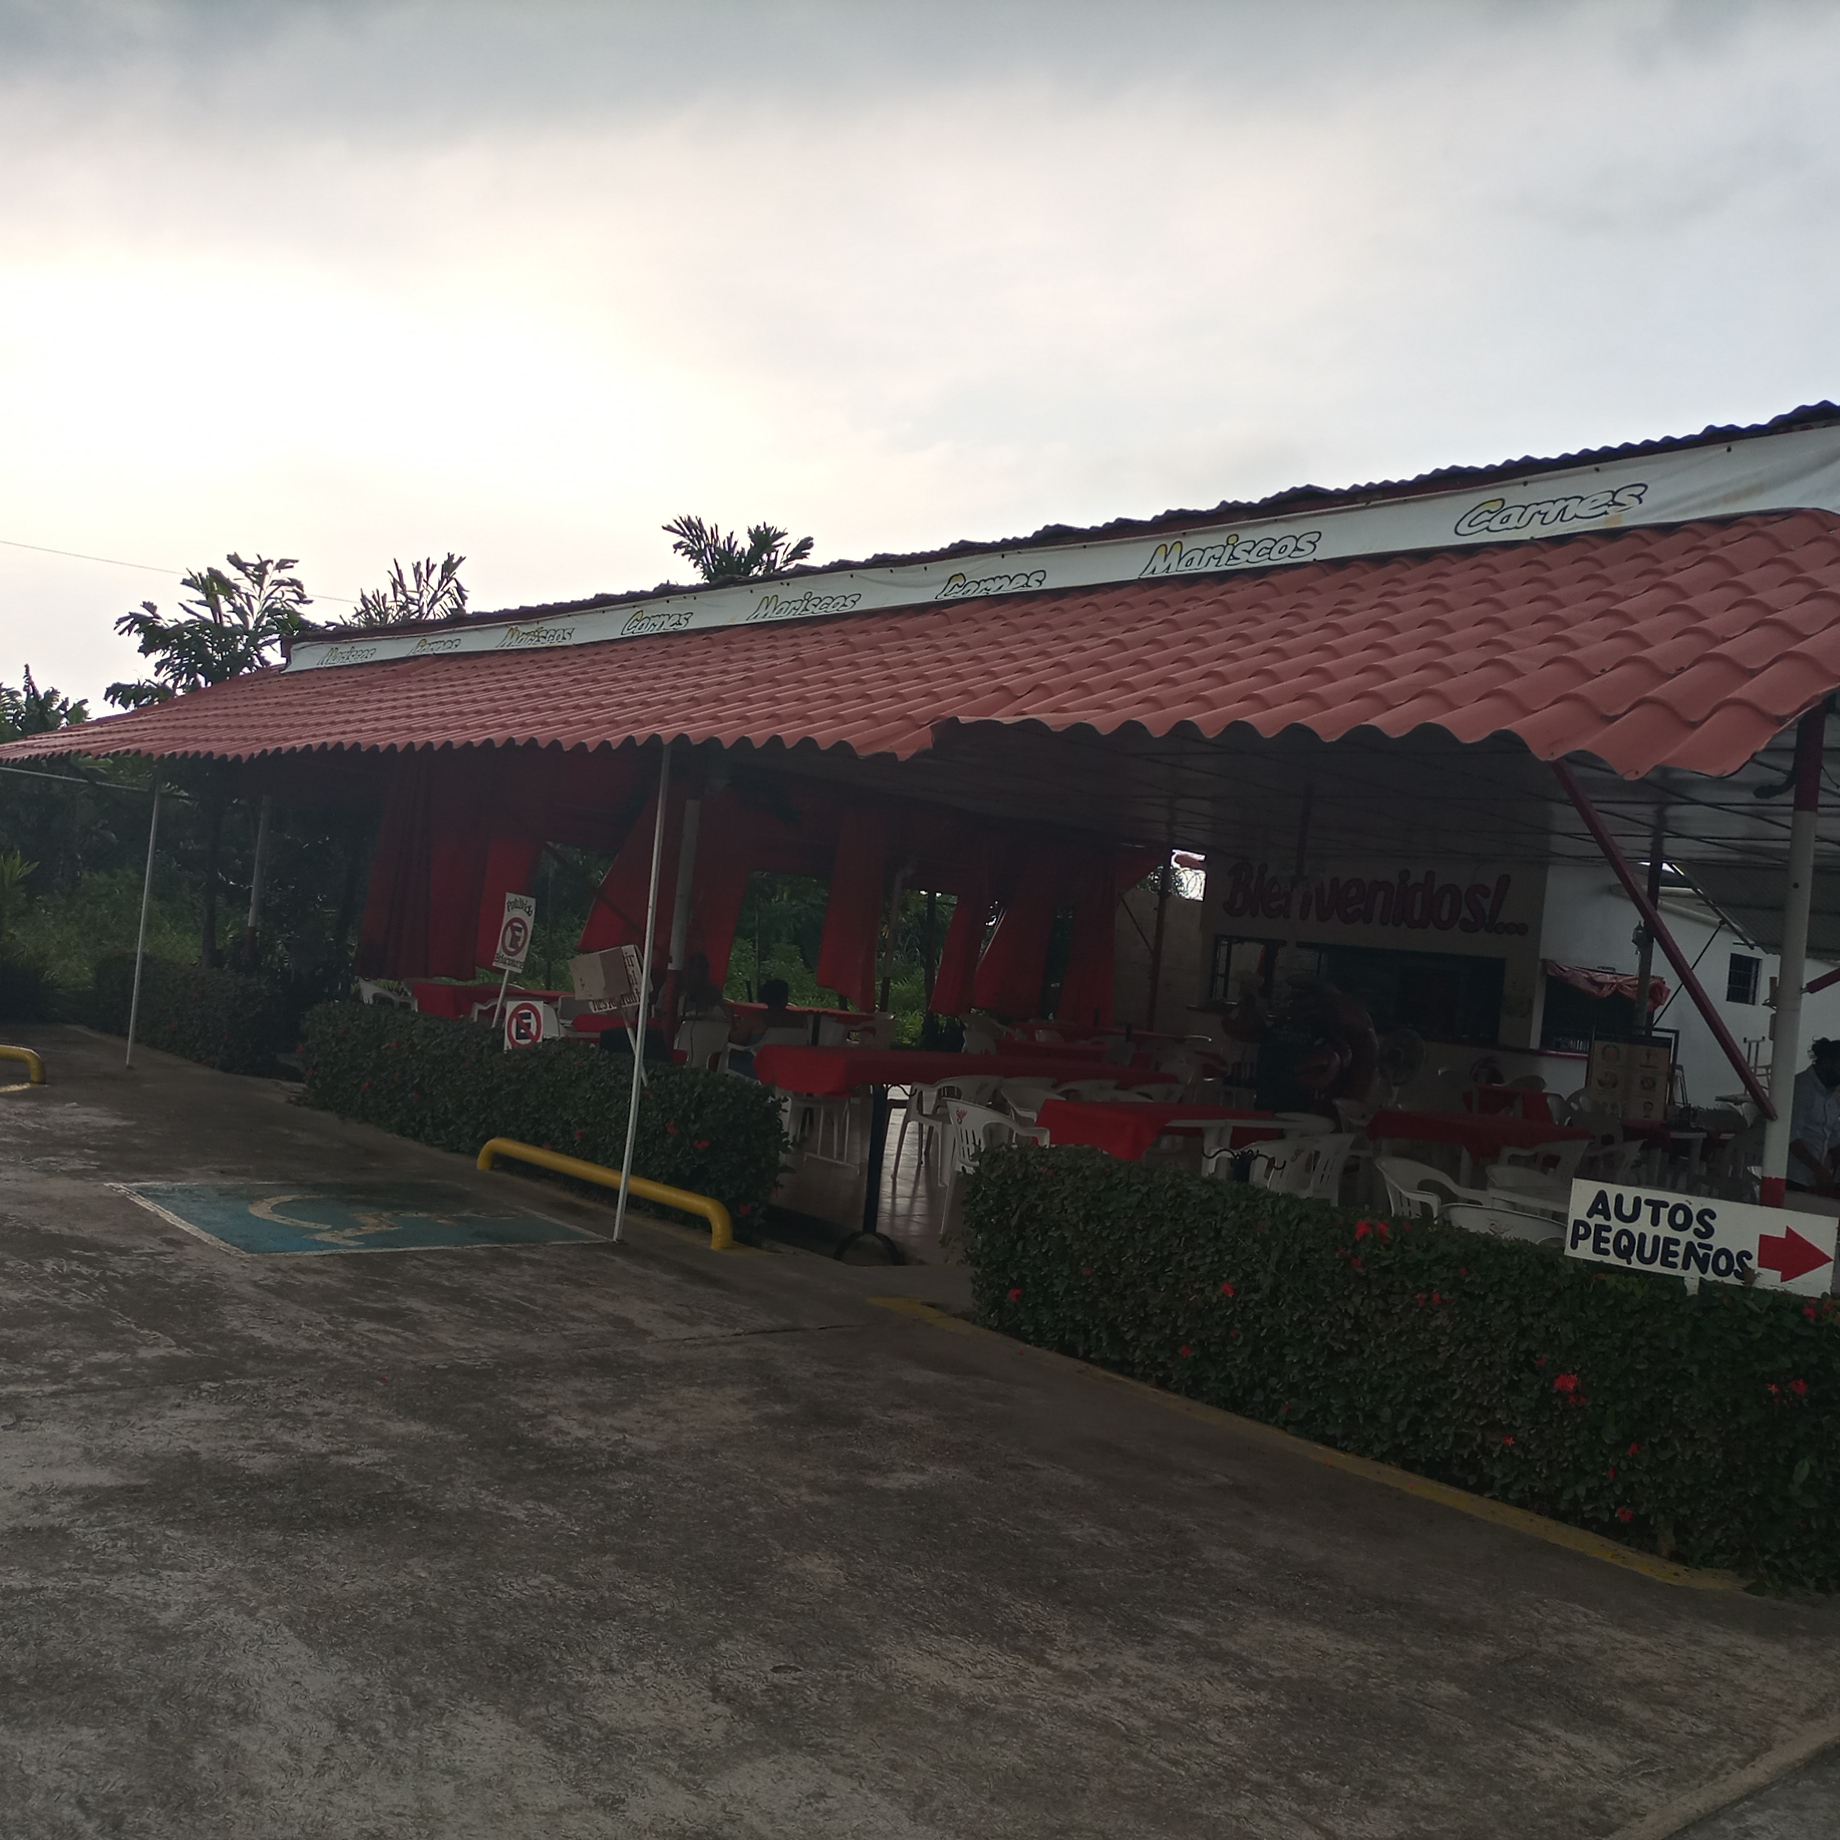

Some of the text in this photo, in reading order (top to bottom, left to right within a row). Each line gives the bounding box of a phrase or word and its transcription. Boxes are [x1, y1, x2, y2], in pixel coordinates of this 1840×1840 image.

[495, 626, 576, 648] Mariscos
[620, 610, 694, 635] Carnes
[746, 591, 861, 621] Mariscos
[935, 570, 1046, 599] Carnes
[1139, 530, 1321, 577] Mariscos
[1454, 483, 1648, 537] Carnes
[1587, 1190, 1716, 1239] AUTOS
[1570, 1219, 1753, 1280] PEQUEÑOS
